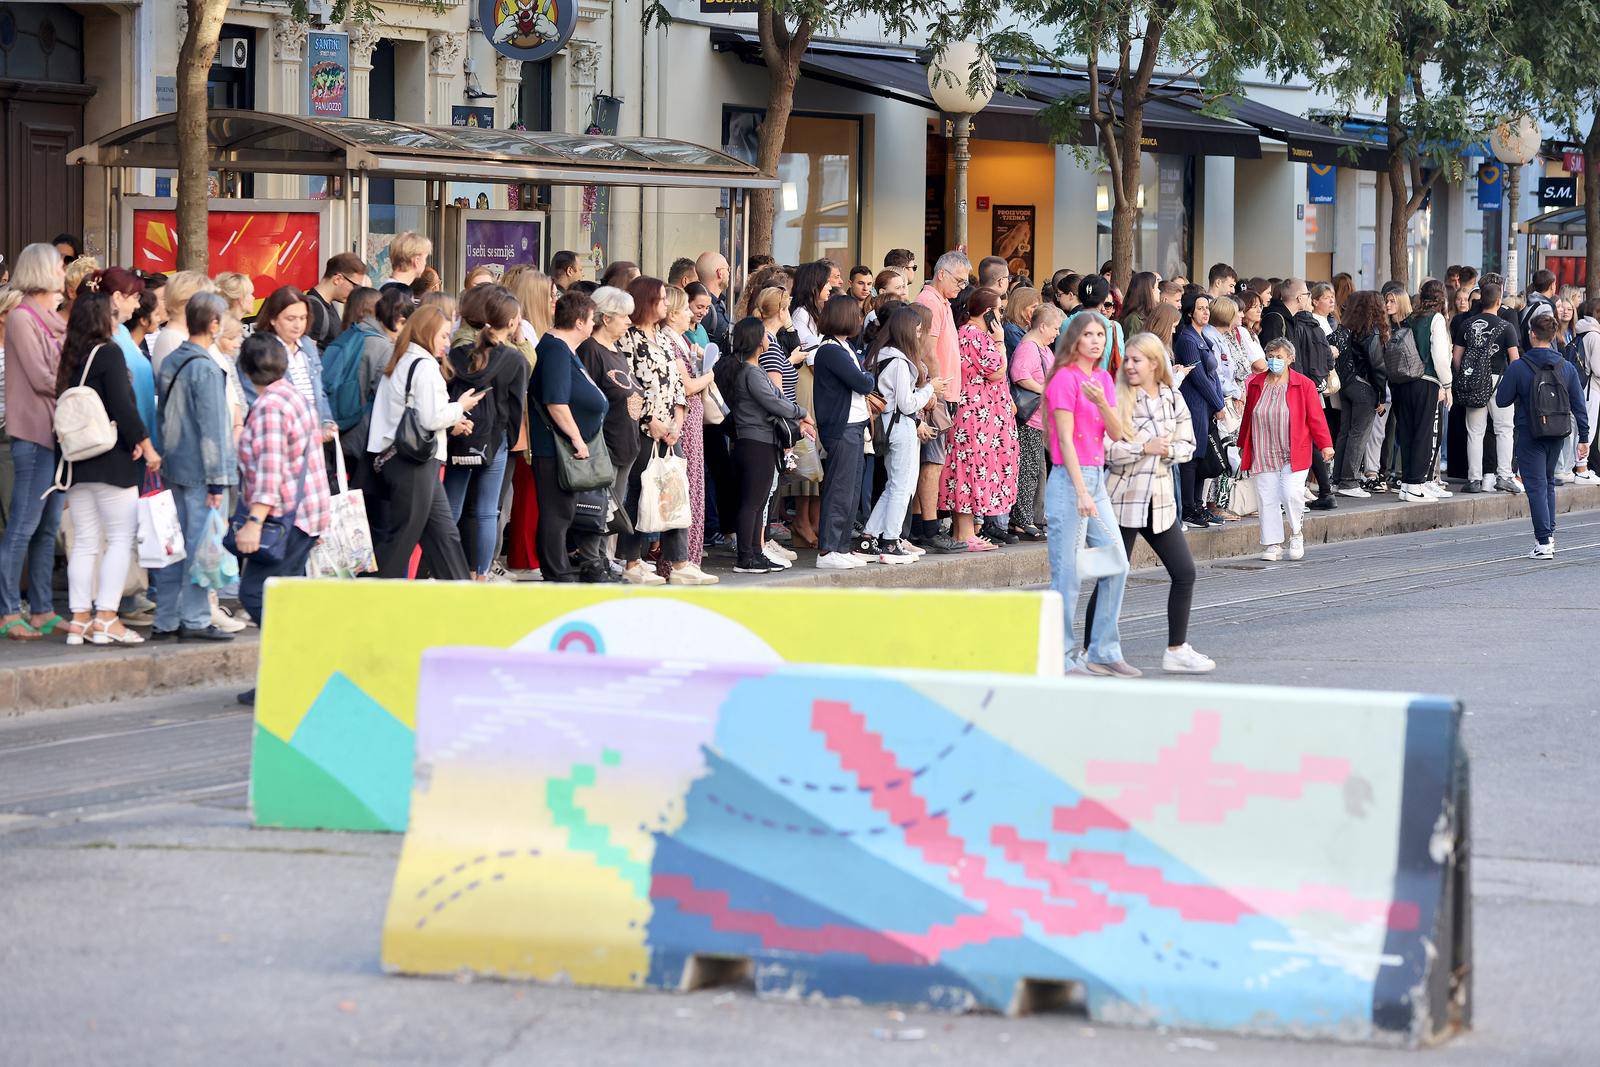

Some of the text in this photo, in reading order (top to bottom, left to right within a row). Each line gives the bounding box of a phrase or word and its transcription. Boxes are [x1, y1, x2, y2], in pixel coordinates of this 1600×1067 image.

[1543, 186, 1572, 199] S.M.
[466, 244, 472, 257] U
[472, 244, 486, 257] sebi
[493, 244, 515, 260] smiješ
